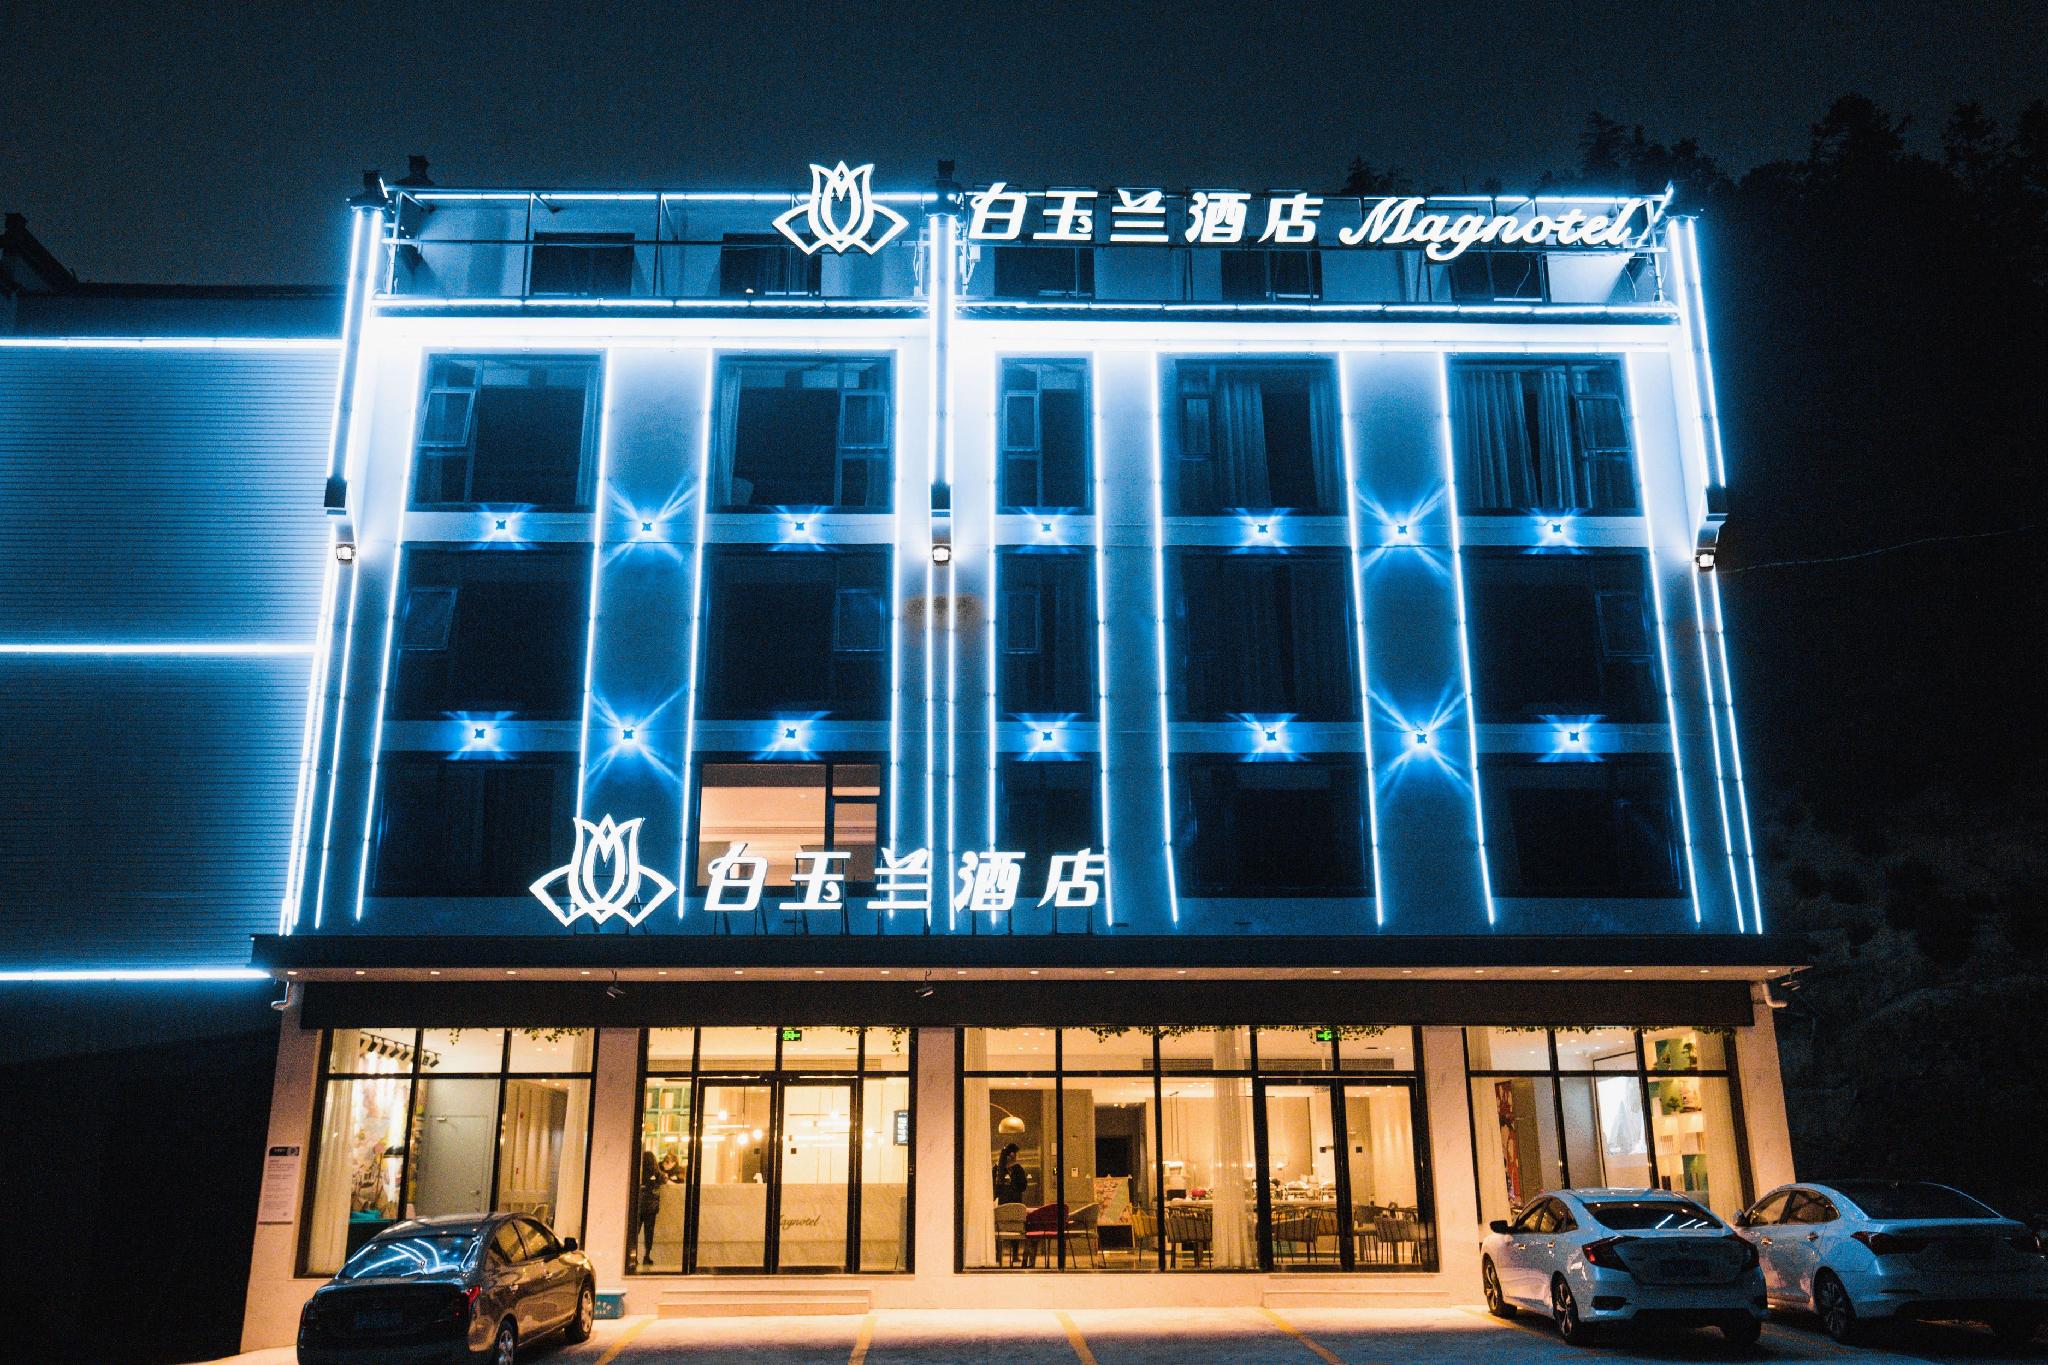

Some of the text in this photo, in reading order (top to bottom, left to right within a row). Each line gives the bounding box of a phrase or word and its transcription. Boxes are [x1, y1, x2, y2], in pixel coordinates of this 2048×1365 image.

[968, 182, 1323, 243] 白玉兰酒店
[1339, 196, 1643, 261] Magnotel
[704, 843, 1107, 911] 白玉兰酒店
